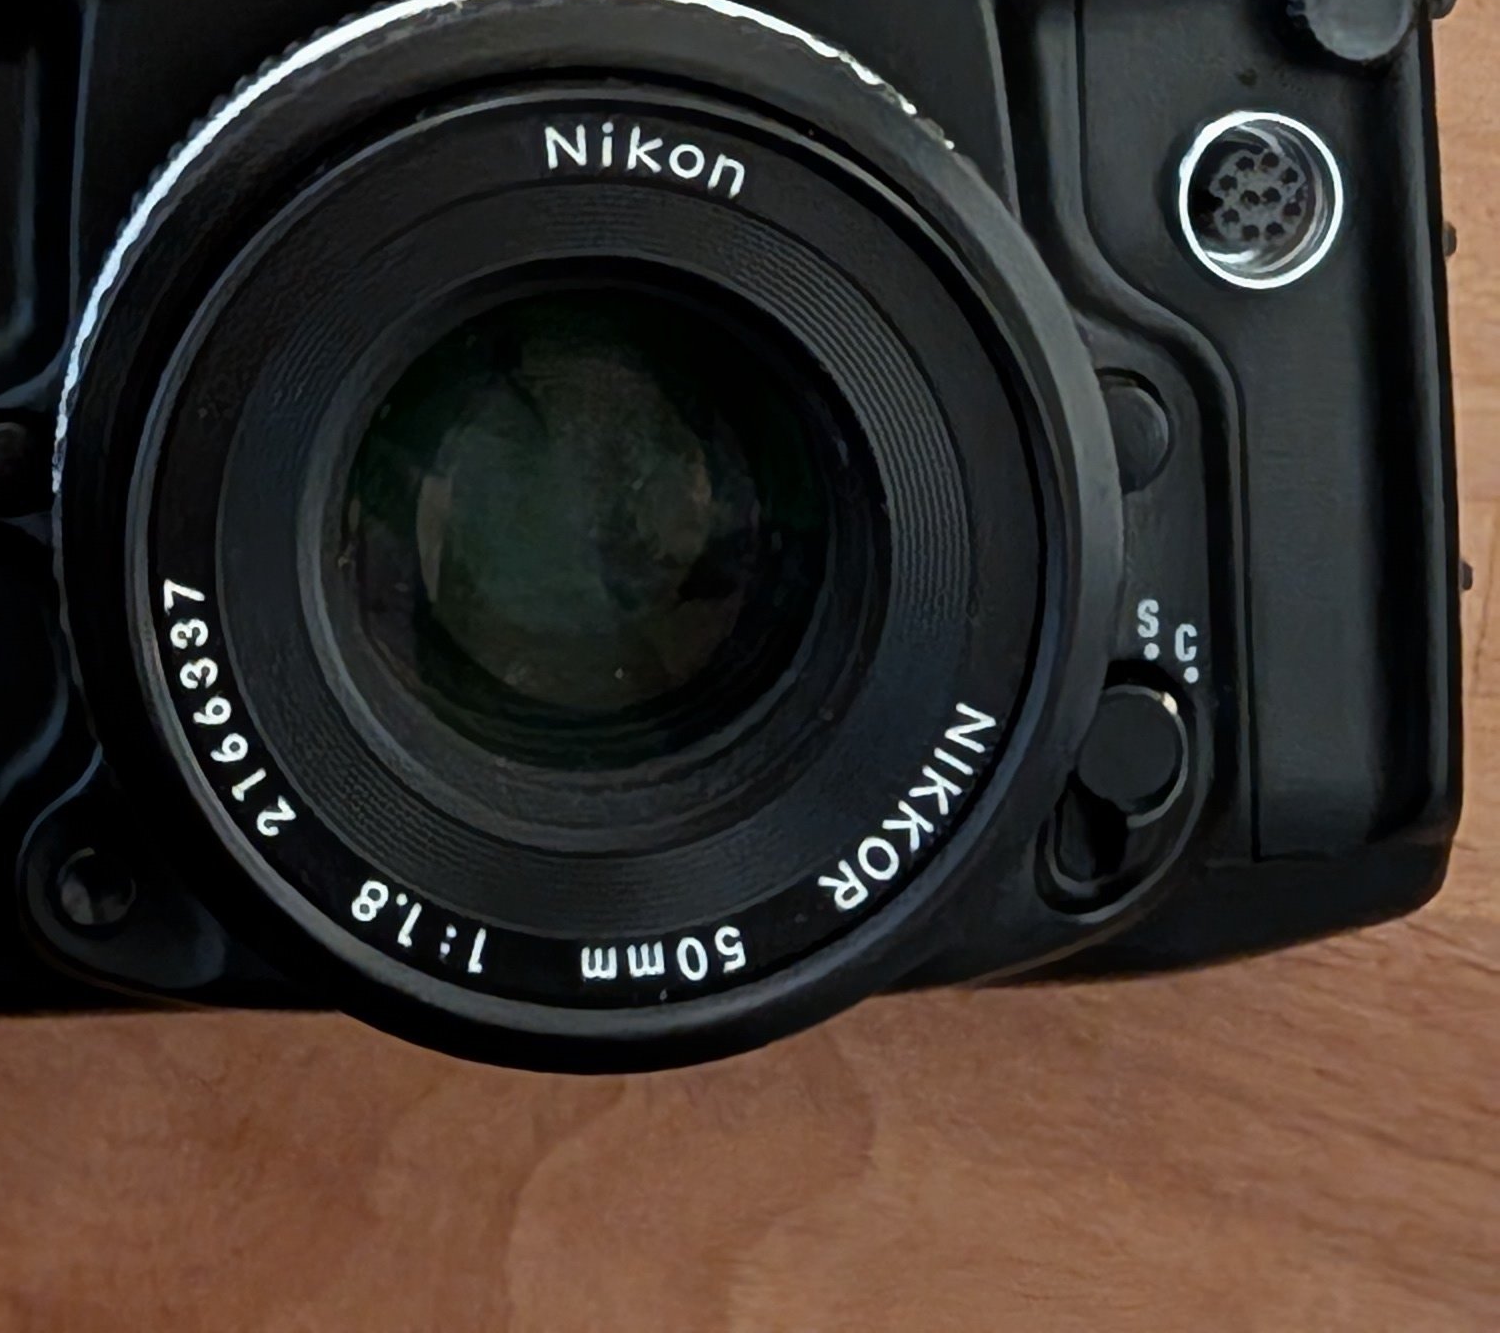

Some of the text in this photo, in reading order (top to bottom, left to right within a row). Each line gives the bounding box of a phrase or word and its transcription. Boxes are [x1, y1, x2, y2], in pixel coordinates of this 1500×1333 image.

[543, 120, 747, 200] Nikon
[1135, 597, 1160, 639] S
[1173, 622, 1199, 663] C
[162, 577, 998, 983] NIKKOR 50mm 1:1.8 2166337
